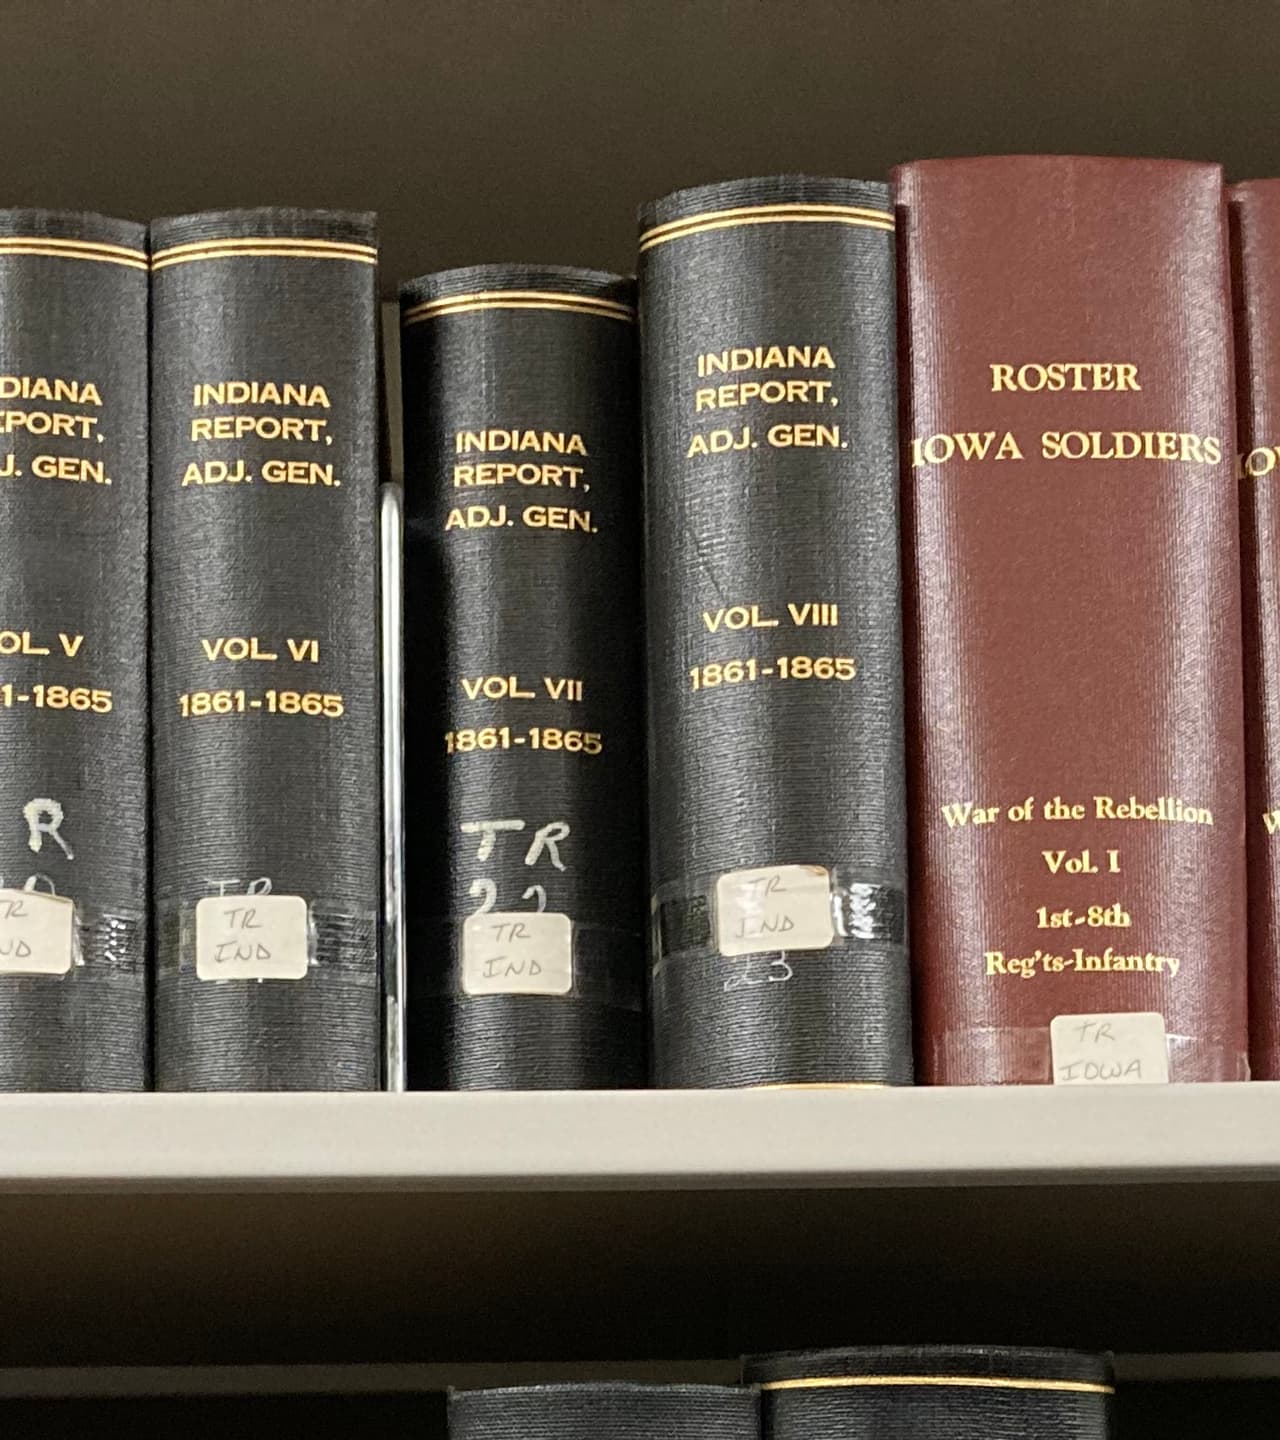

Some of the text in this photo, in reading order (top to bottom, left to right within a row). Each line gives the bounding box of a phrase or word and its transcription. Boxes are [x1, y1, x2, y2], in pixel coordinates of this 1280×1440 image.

[698, 346, 835, 377] INDIANA
[990, 364, 1140, 392] ROSTER
[695, 381, 838, 411] REPORT,
[687, 424, 848, 457] ADJ. GEN.
[911, 432, 1222, 468] IOWA SOLDIERS
[703, 604, 838, 632] VOL. VIII
[689, 658, 856, 691] 1861-1865
[941, 797, 1213, 828] War of the Rebellion
[1042, 850, 1121, 873] Vol. I
[746, 876, 784, 896] TR
[736, 915, 795, 938] IND
[1036, 904, 1132, 929] 1st-8th
[1075, 1021, 1116, 1042] TR
[1060, 1059, 1142, 1081] IOWA
